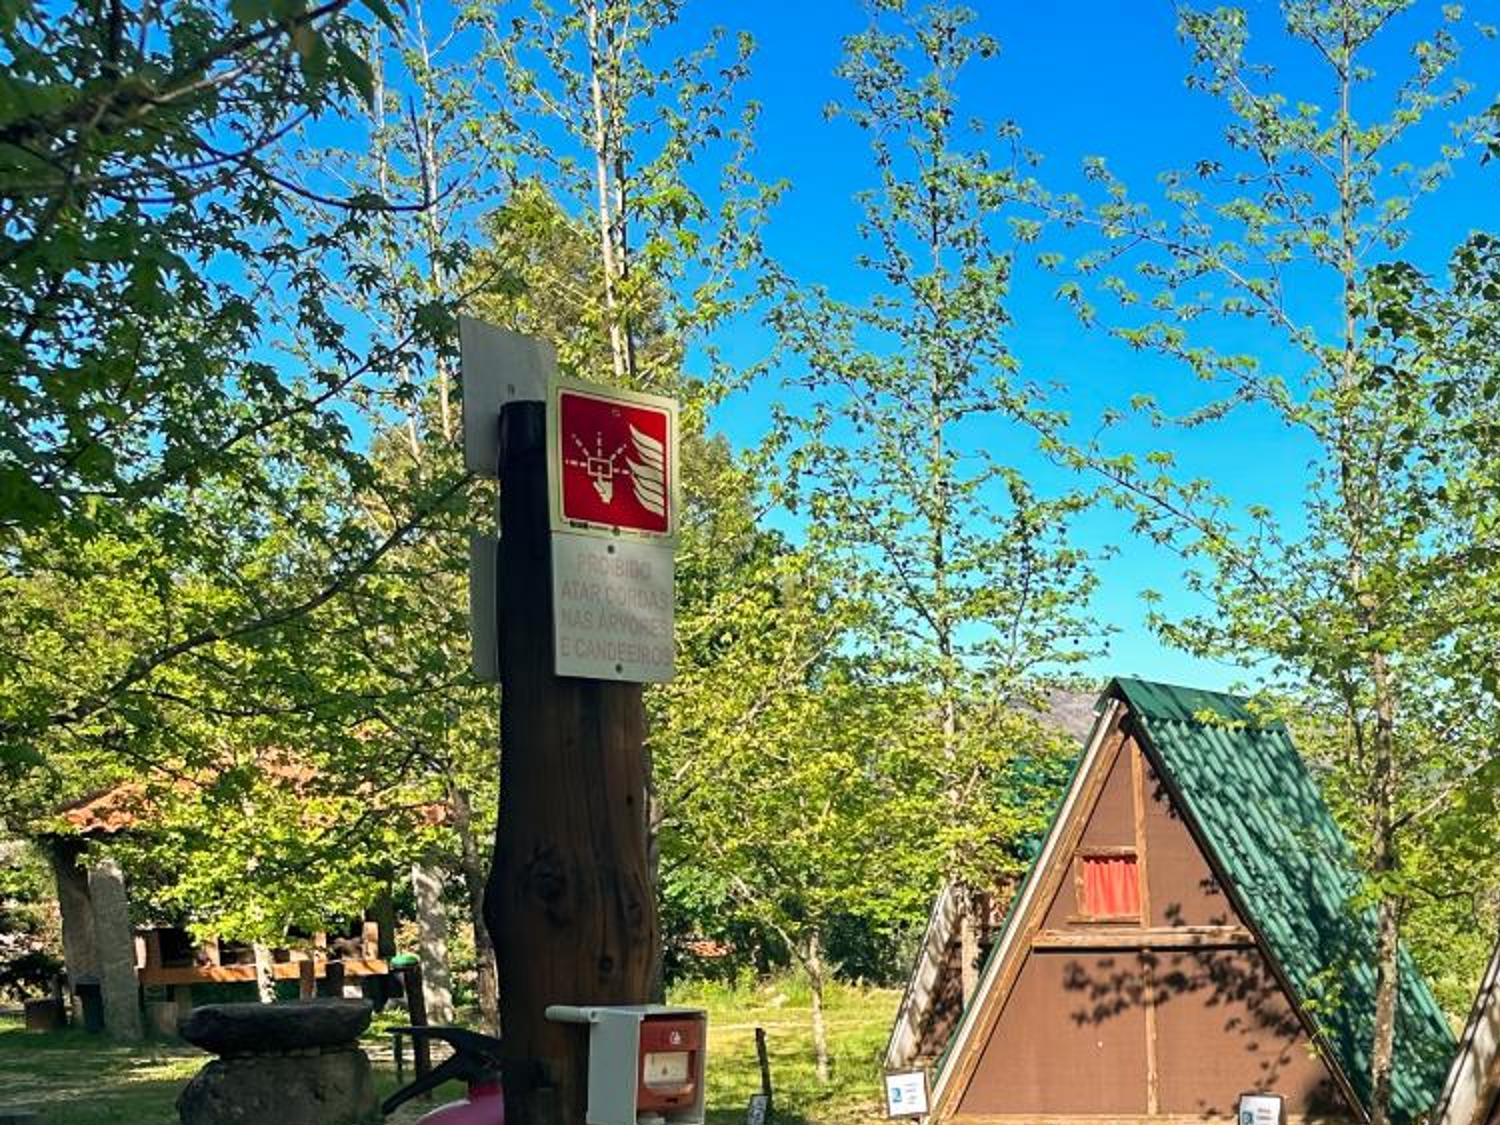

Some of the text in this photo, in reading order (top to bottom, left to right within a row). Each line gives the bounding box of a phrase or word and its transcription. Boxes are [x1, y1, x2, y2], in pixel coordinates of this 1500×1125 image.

[577, 553, 652, 580] PROIBIDO
[561, 582, 601, 606] ATAR
[562, 609, 593, 632] NAS
[561, 637, 571, 657] E
